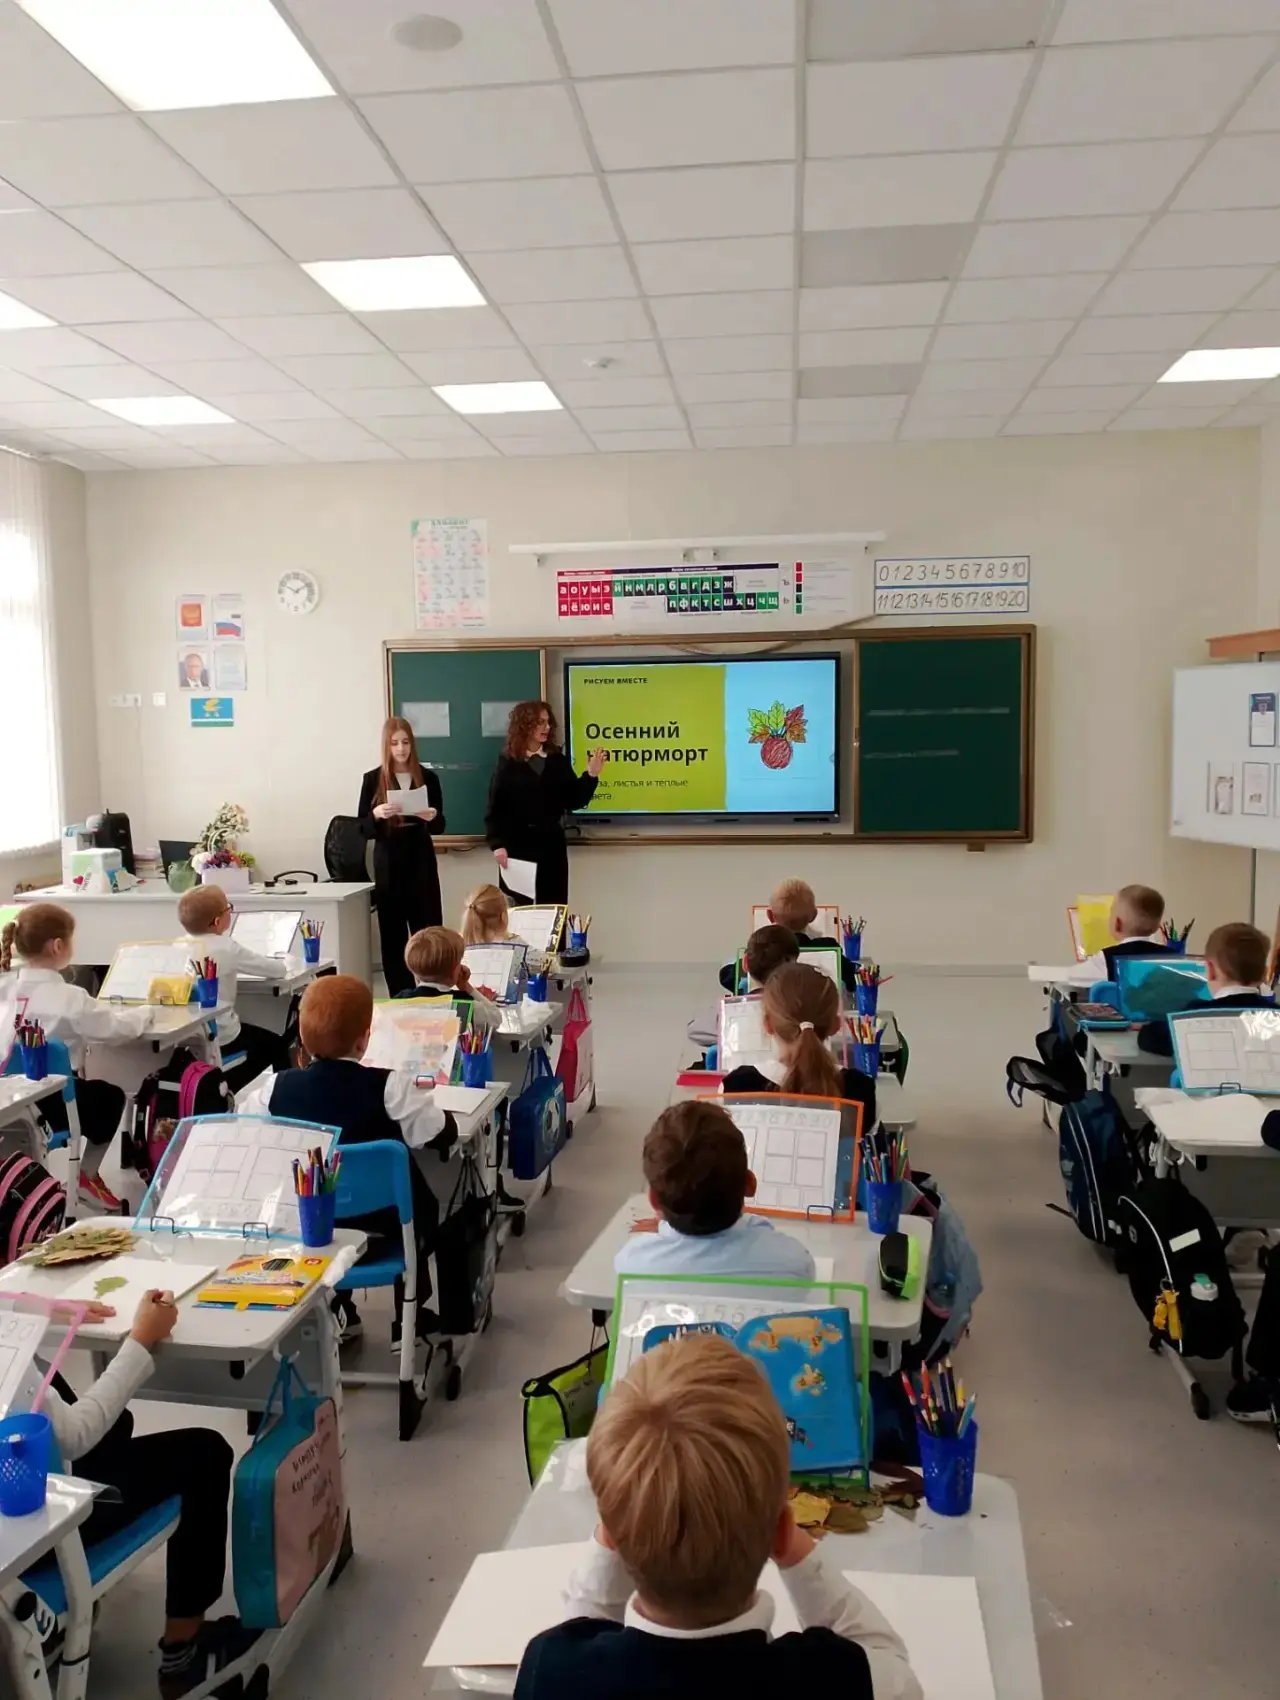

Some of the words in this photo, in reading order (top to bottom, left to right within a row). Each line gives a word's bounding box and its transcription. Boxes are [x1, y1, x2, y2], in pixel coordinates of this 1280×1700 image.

[879, 566, 889, 581] 0
[893, 565, 900, 580] 1
[902, 565, 914, 581] 2
[917, 564, 927, 580] 3
[930, 565, 940, 580] 4
[945, 564, 956, 580] 5
[959, 564, 970, 579] 6
[972, 563, 982, 578] 7
[985, 562, 995, 578] 8
[999, 562, 1009, 578] 9
[1012, 562, 1025, 578] 10
[877, 594, 889, 609] 11
[890, 593, 903, 609] 12
[905, 593, 918, 608] 13
[920, 593, 932, 608] 14
[935, 592, 949, 608] 15
[950, 592, 963, 608] 16
[966, 592, 980, 607] 17
[981, 591, 993, 607] 18
[994, 591, 1008, 607] 19
[1008, 591, 1026, 607] 20
[586, 721, 680, 739] Осенний
